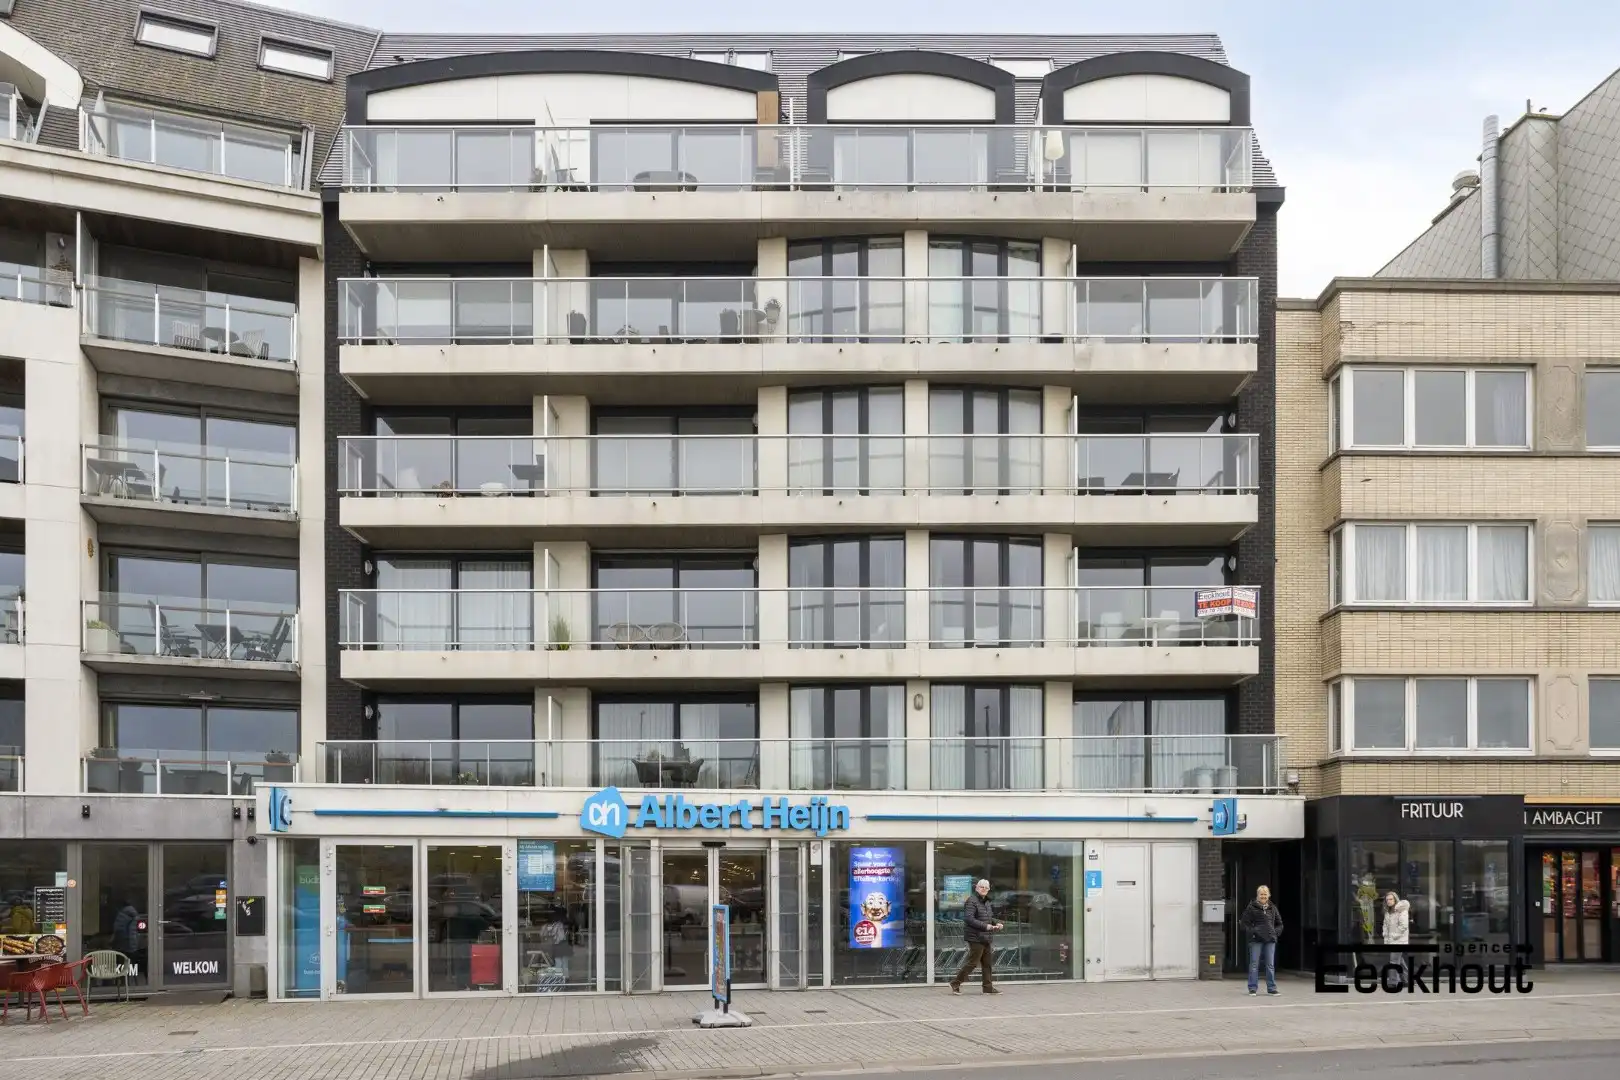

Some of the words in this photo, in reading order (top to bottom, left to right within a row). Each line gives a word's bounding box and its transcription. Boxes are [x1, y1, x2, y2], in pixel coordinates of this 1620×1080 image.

[1210, 600, 1231, 608] KOOP
[635, 795, 753, 830] Albert
[763, 796, 849, 837] Heijn
[1401, 802, 1464, 819] FRITUUR
[1532, 811, 1603, 825] AMBACHT
[173, 960, 219, 975] WELKOM
